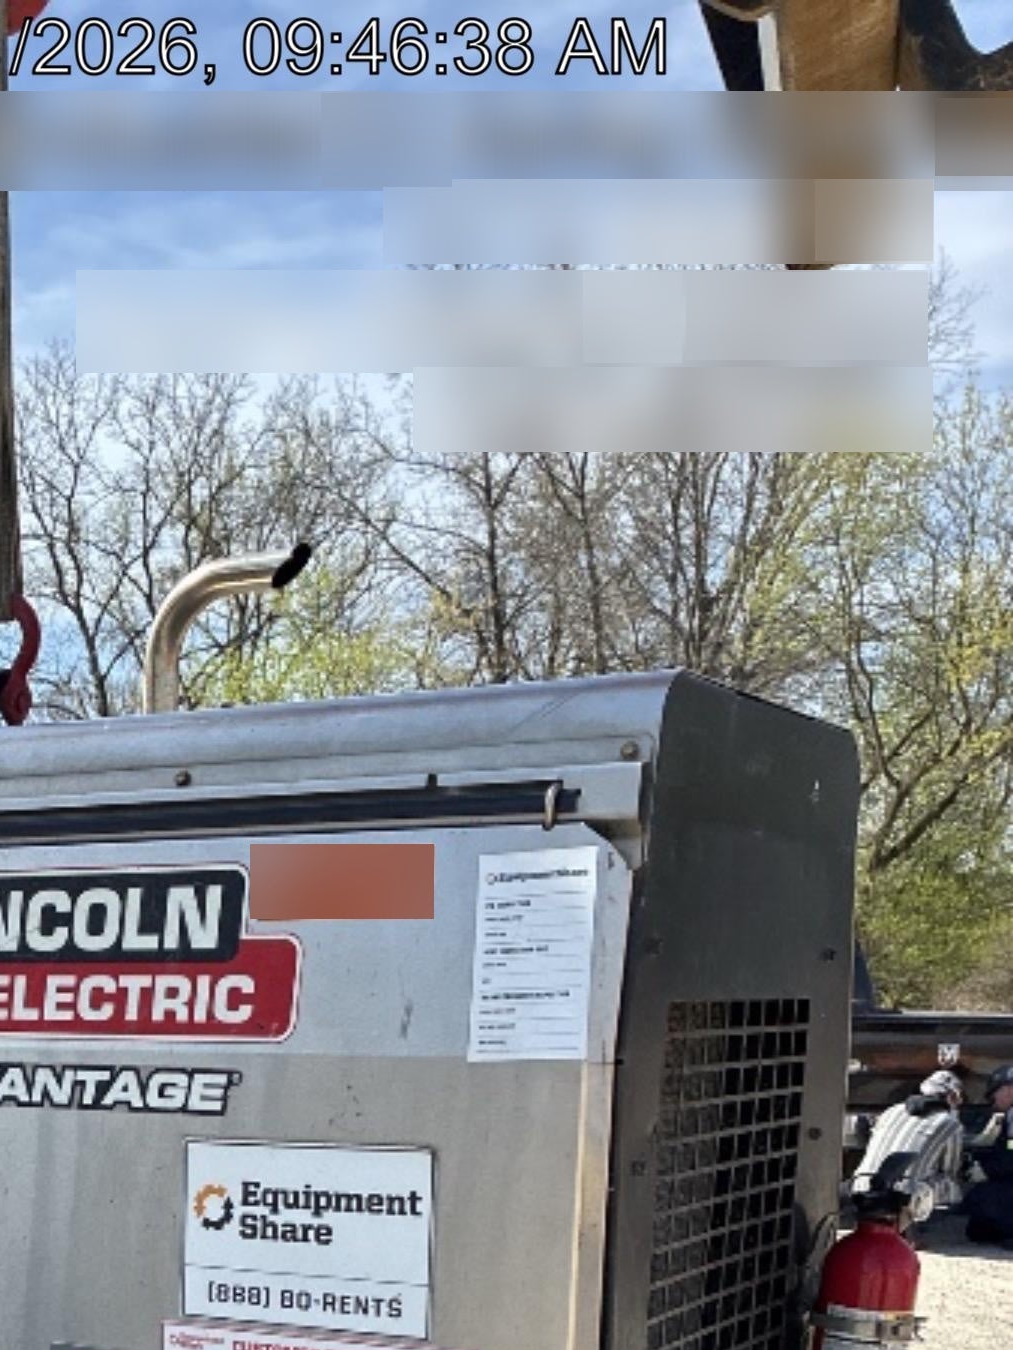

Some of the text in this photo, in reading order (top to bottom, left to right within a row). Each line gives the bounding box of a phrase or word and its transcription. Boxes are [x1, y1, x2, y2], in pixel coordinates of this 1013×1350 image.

[240, 1180, 424, 1217] Equipment
[238, 1213, 333, 1246] Share
[279, 1289, 403, 1318] 80-RENTS
